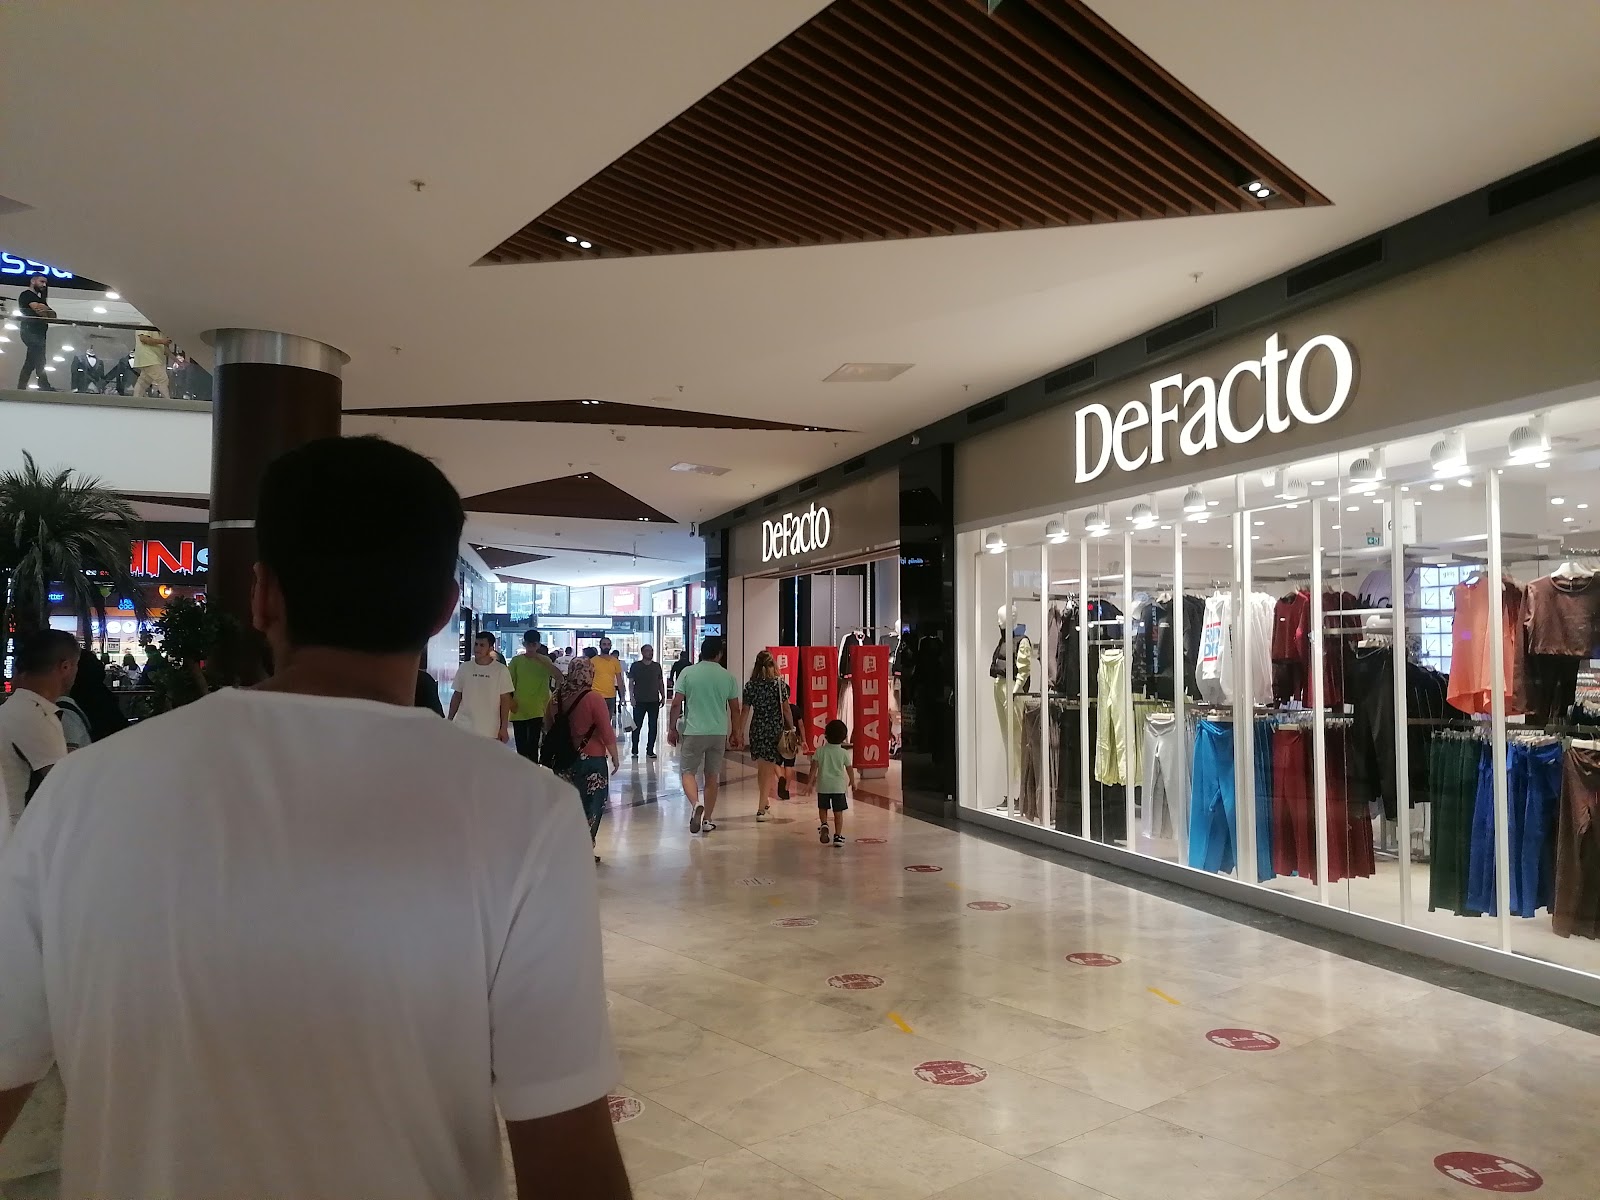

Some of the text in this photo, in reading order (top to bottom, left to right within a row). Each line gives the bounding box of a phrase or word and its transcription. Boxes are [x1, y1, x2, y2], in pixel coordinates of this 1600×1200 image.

[1074, 331, 1354, 485] DeFacto
[761, 502, 832, 563] DeFacto
[811, 675, 828, 749] SALE
[861, 679, 880, 762] SALE
